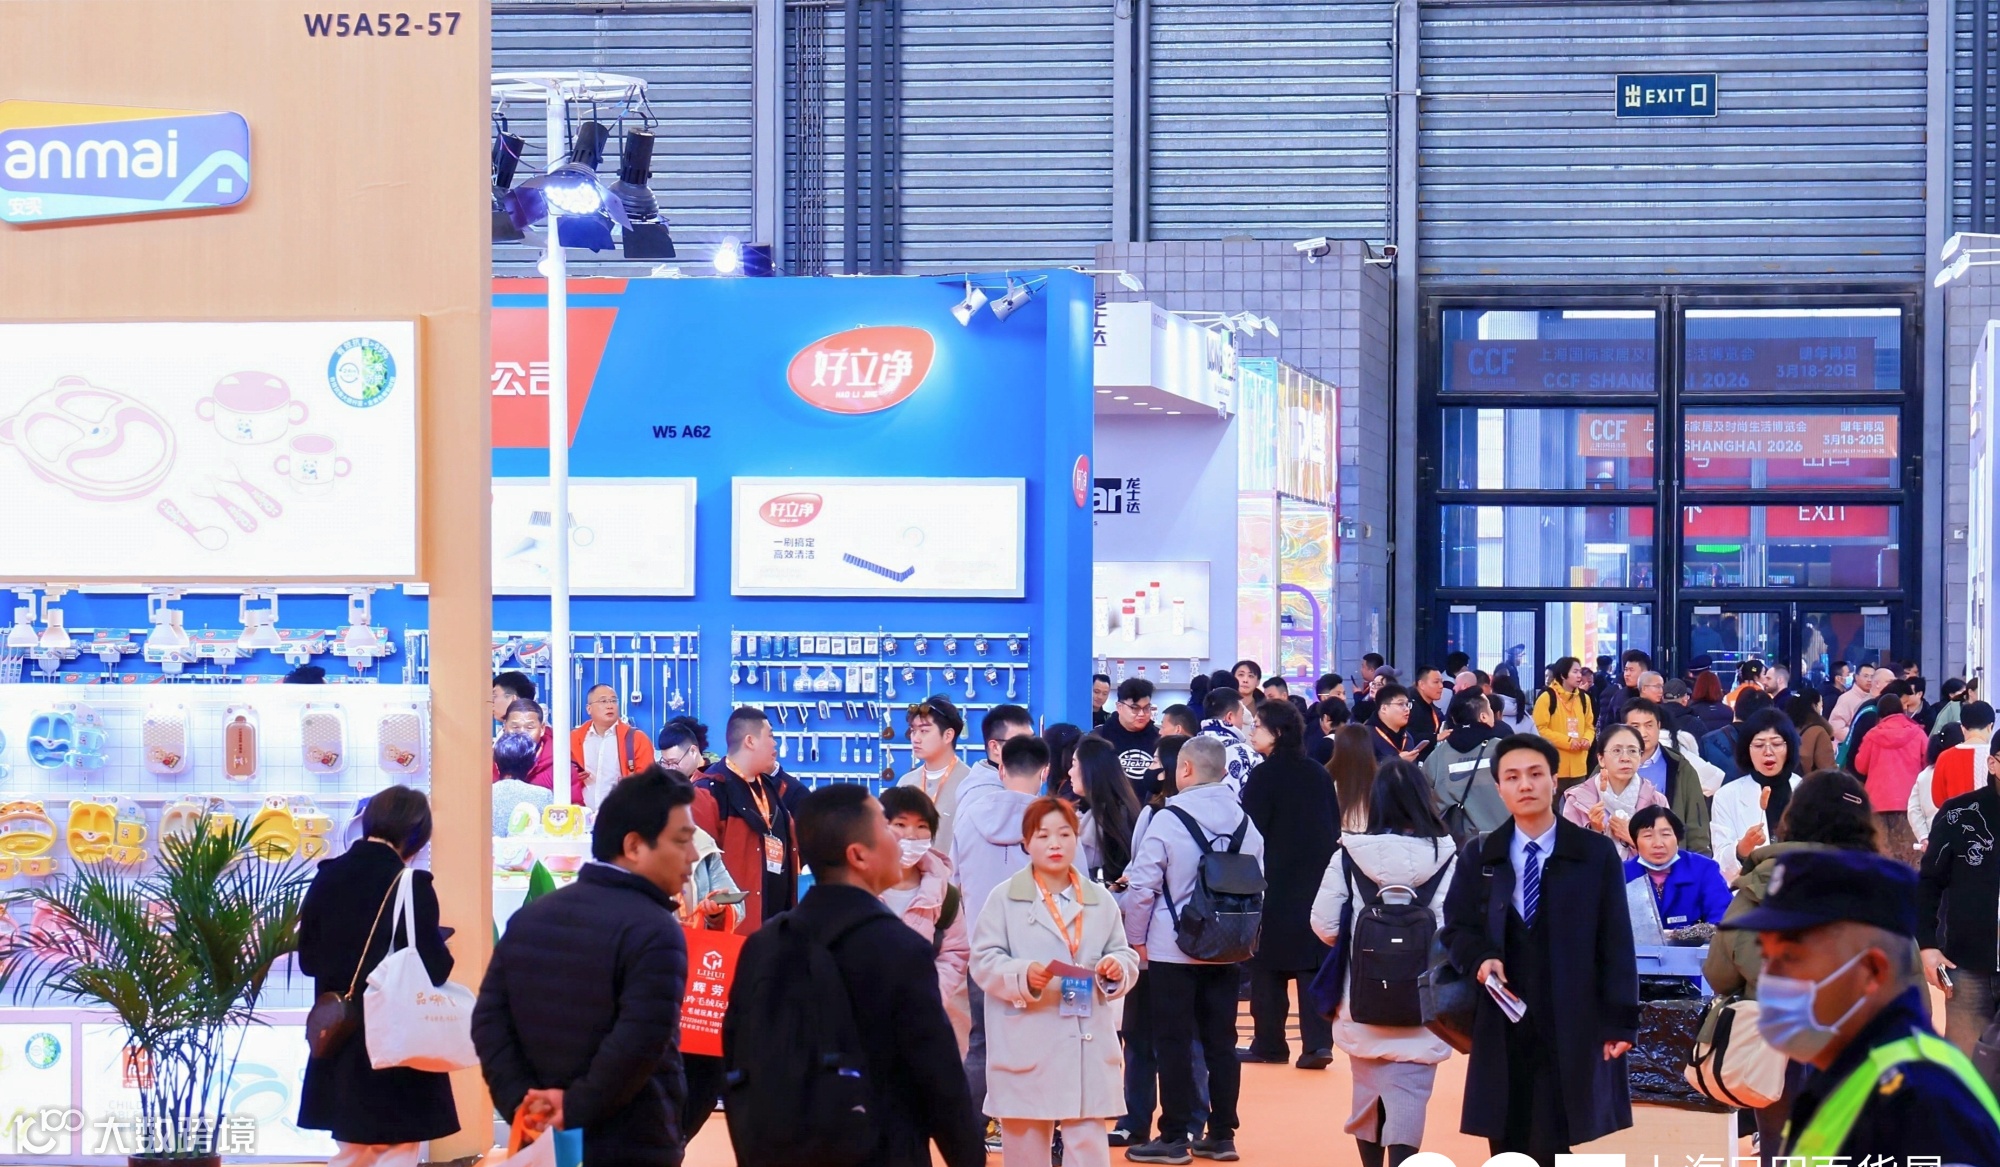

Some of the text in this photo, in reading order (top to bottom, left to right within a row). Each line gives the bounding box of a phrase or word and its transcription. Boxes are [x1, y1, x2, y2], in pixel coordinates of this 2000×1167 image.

[304, 12, 461, 37] W5A52-57
[1625, 84, 1707, 107] 出 EXIT 口
[5, 129, 178, 179] anmai
[1468, 347, 1518, 375] CCF
[491, 361, 549, 396] 公司
[810, 347, 913, 396] 好立净
[1776, 363, 1857, 379] 3月18-20日
[1542, 372, 1579, 389] CCF
[1703, 372, 1750, 388] 2026
[652, 425, 711, 438] W5 A62
[1589, 418, 1628, 441] CCF
[1685, 439, 1804, 452] SHANGHAI 2026
[1822, 433, 1885, 446] 3月18-20日
[1126, 477, 1141, 514] 龙士达
[768, 501, 815, 518] 好立净
[773, 537, 815, 548] 一刷搞定
[773, 549, 815, 560] 高效清洁
[697, 968, 725, 979] LIHUI
